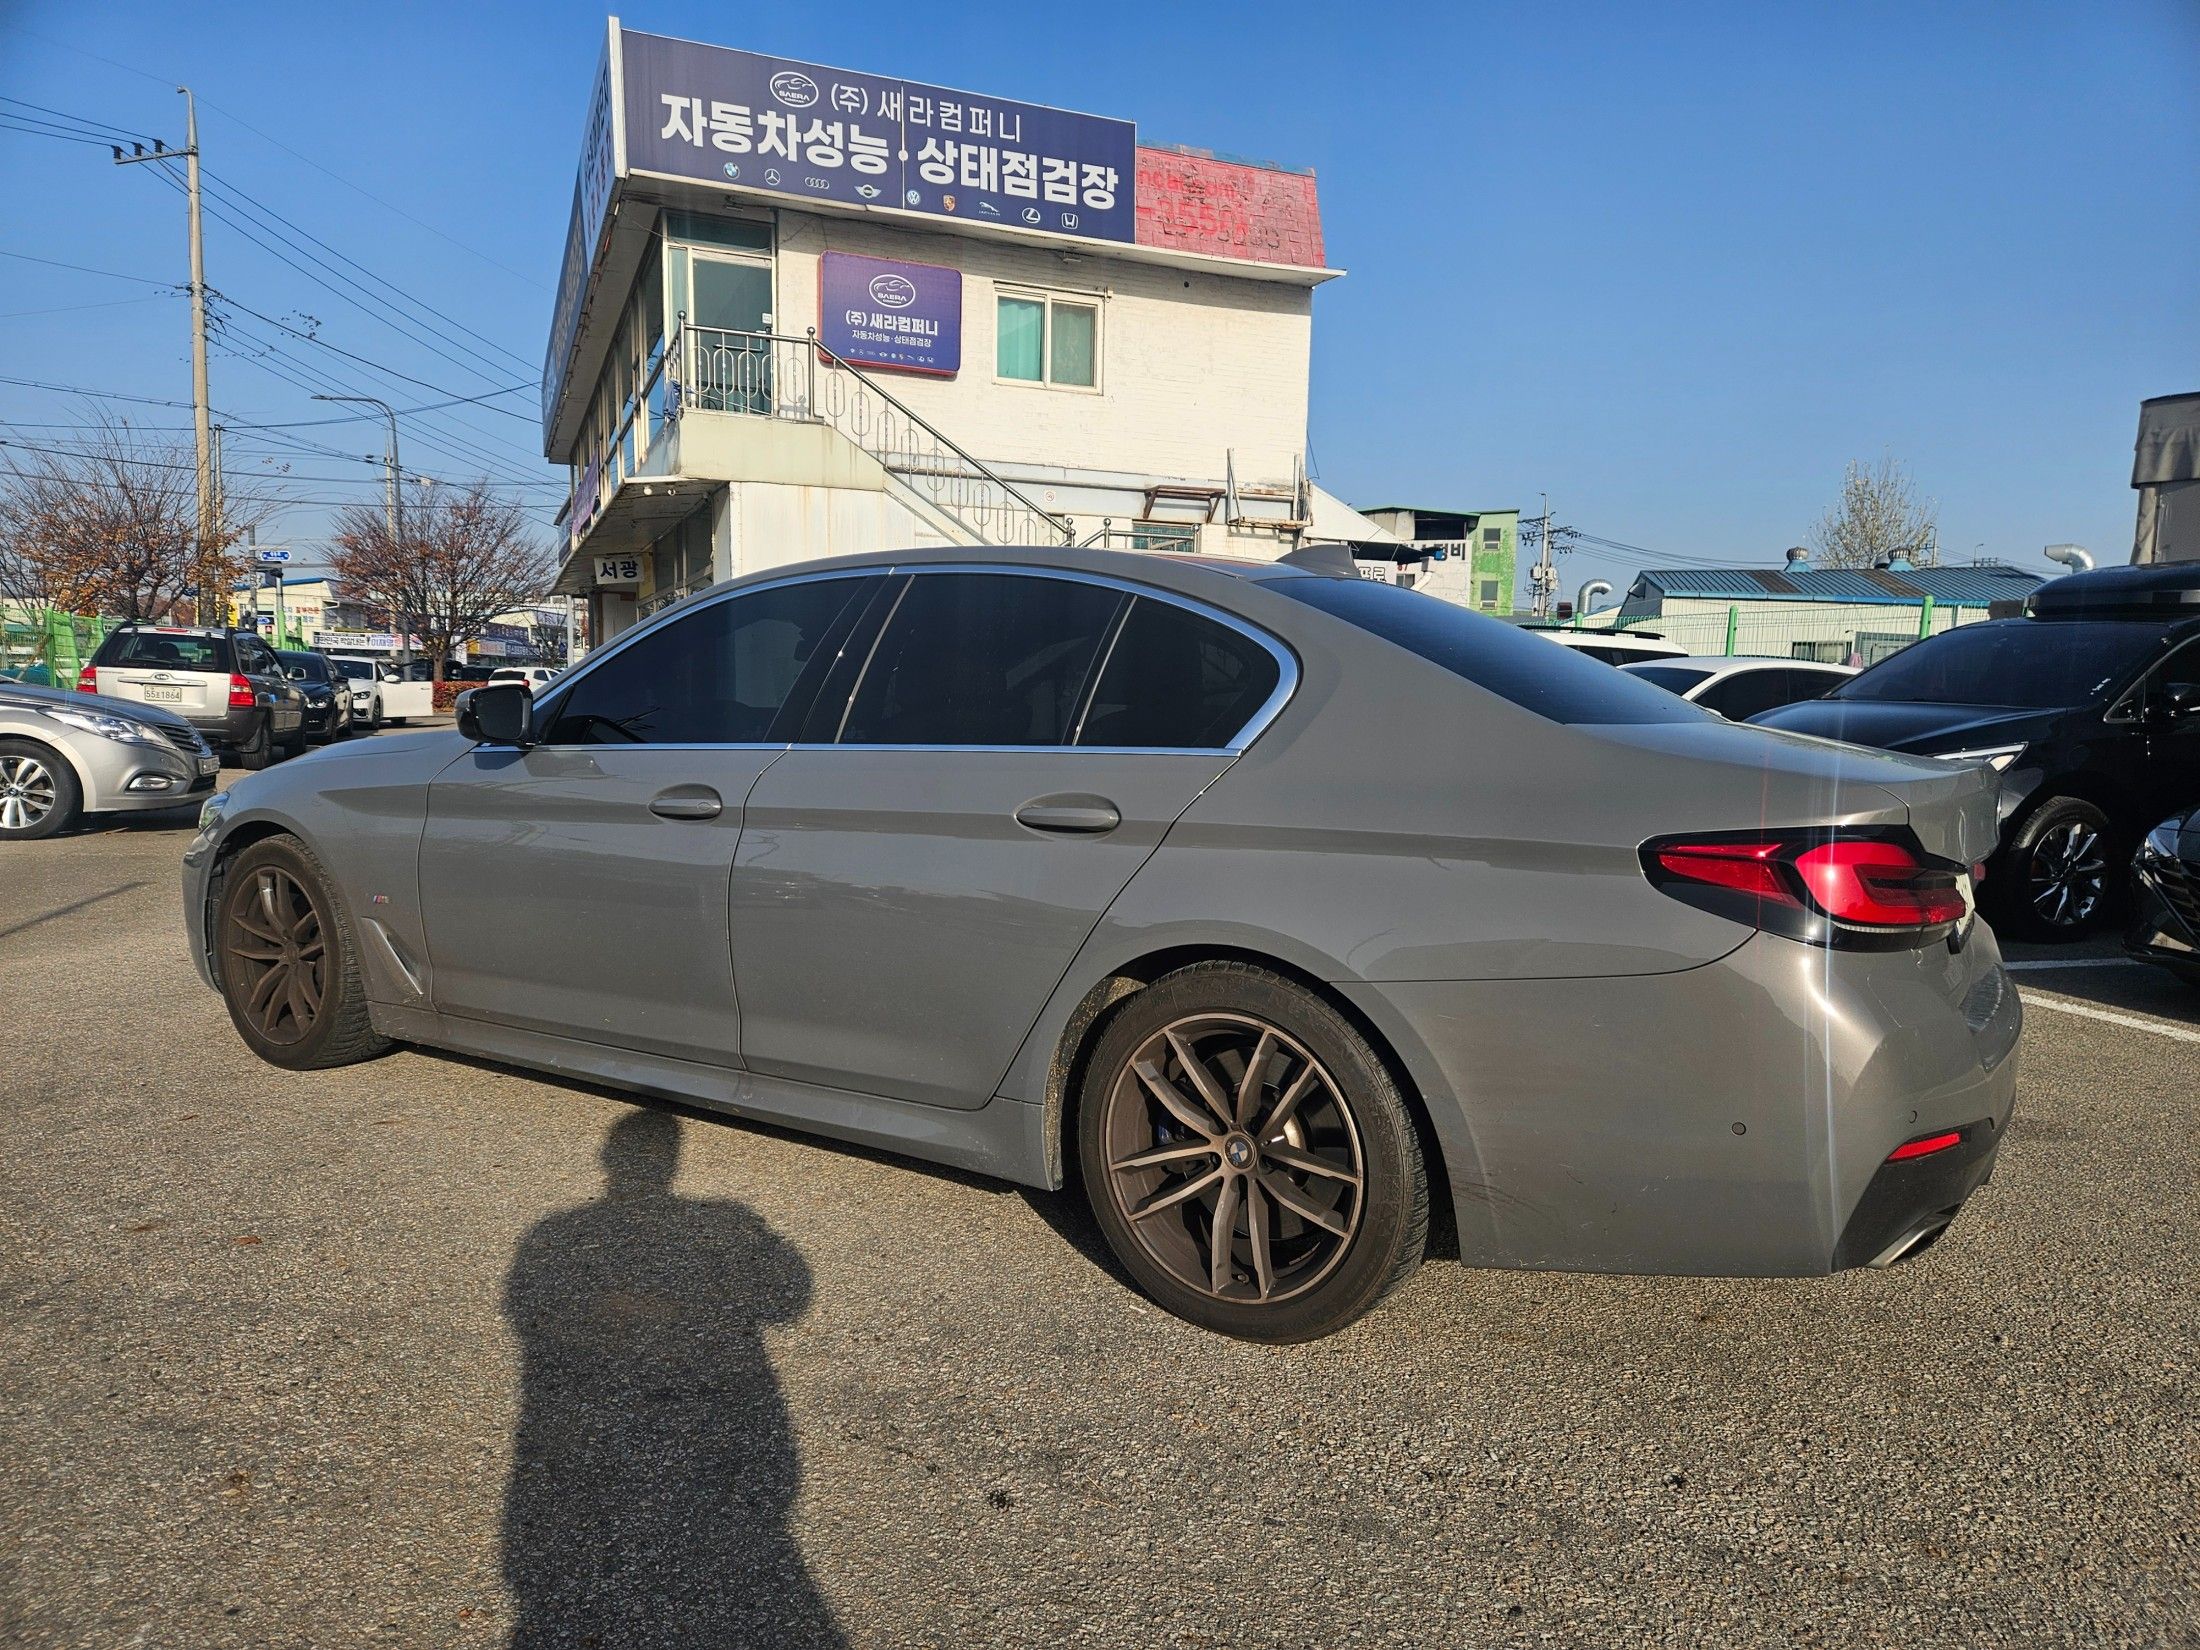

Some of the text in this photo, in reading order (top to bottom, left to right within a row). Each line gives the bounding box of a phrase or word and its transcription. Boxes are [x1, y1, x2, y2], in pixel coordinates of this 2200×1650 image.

[831, 83, 1020, 142] (주) 새라컴퍼니
[845, 309, 938, 336] (주) 새라컴퍼니
[600, 560, 638, 579] 서광
